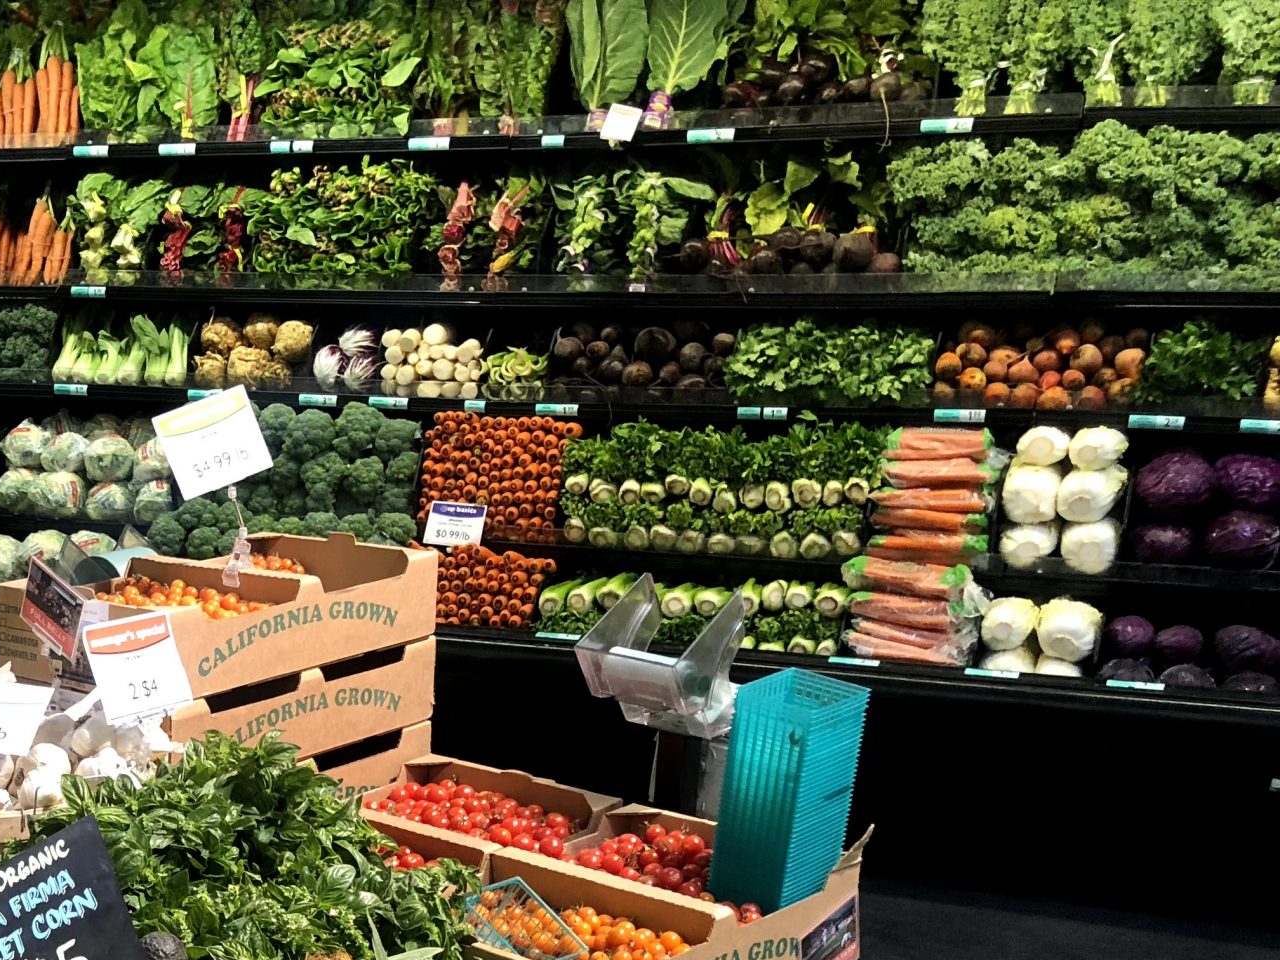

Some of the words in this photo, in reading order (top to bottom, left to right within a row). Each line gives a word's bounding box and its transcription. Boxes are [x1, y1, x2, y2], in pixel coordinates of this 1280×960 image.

[197, 603, 324, 678] CALIFORNIA
[328, 600, 399, 628] GROWN
[233, 691, 330, 746] LIFORNIA
[335, 687, 402, 713] GROWN
[8, 868, 76, 919] FIRMA
[31, 887, 99, 941] CORN
